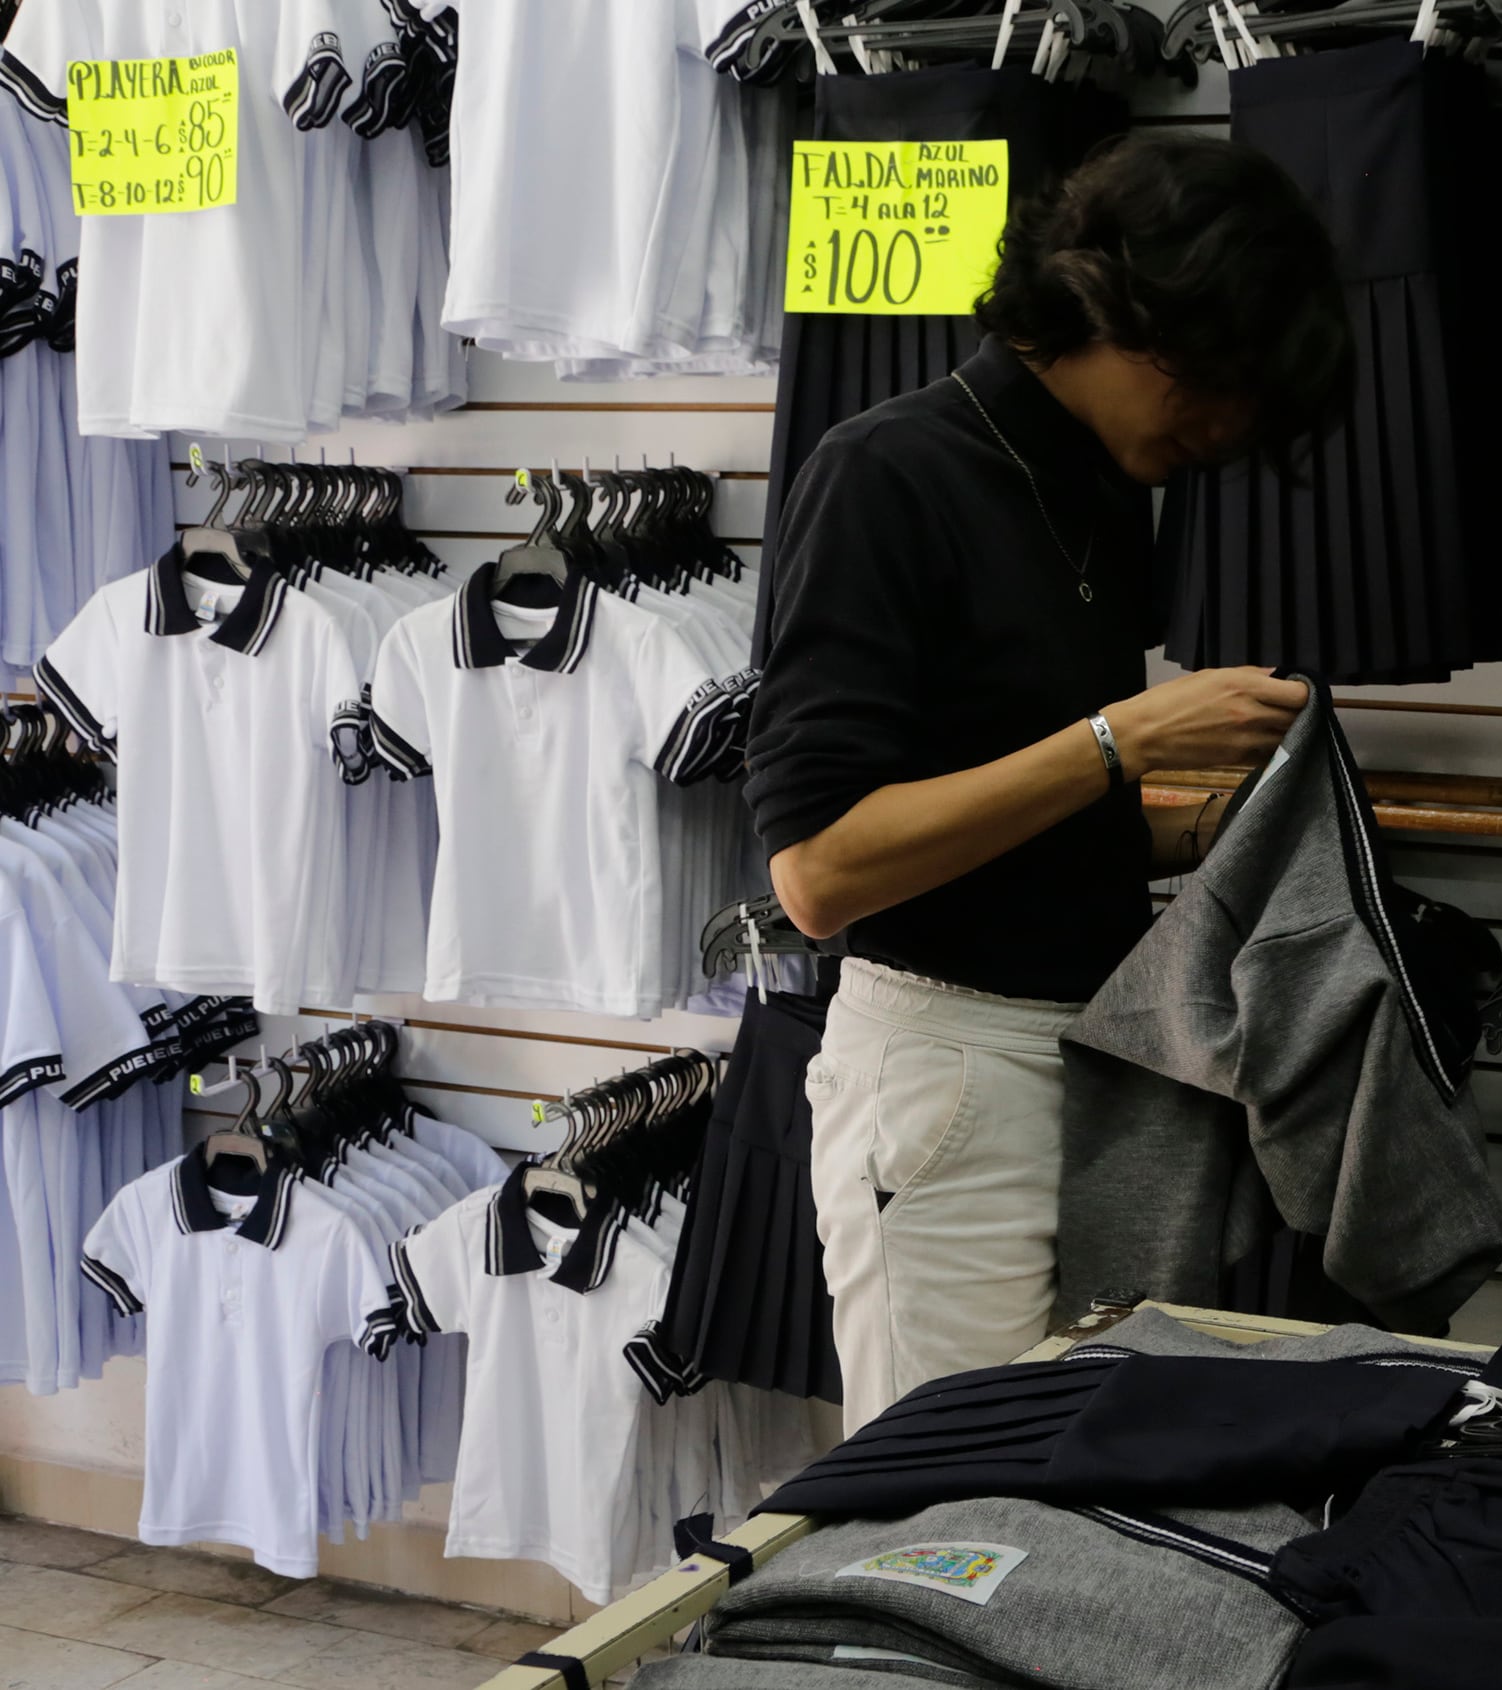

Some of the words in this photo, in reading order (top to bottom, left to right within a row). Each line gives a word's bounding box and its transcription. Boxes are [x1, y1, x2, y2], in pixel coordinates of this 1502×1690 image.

[190, 75, 220, 95] AZUL
[918, 142, 969, 162] AZUL
[915, 163, 999, 189] MARINO
[923, 192, 950, 219] 12
